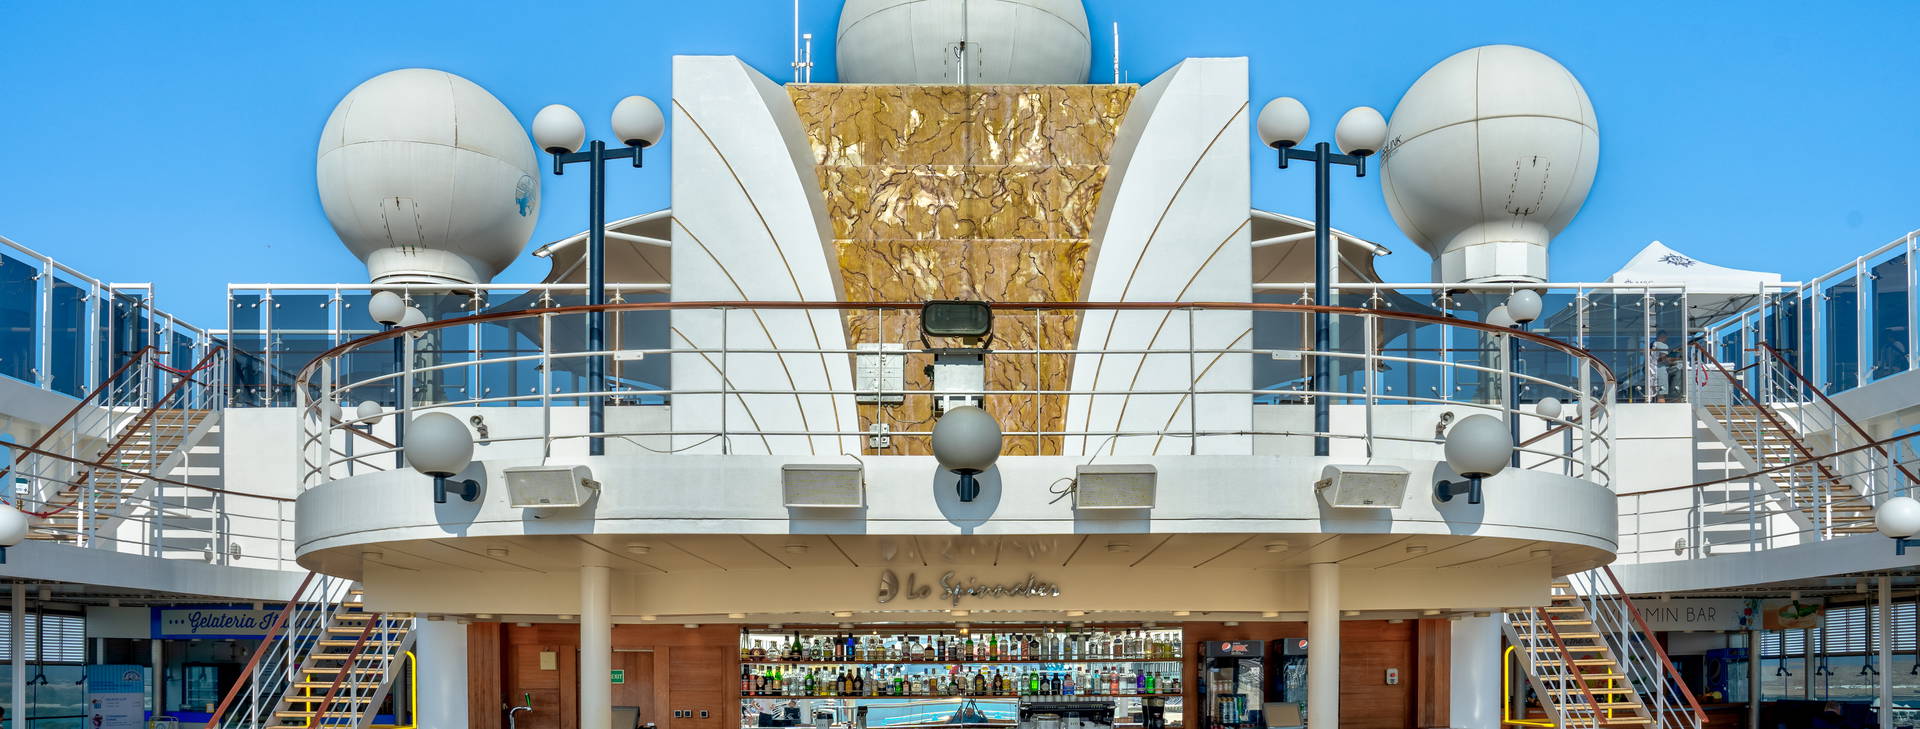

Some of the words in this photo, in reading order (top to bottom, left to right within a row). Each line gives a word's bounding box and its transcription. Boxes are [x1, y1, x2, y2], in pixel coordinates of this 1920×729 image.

[907, 572, 932, 600] Lo
[188, 611, 257, 633] Gelateria
[1604, 607, 1679, 623] VIAMIN
[1687, 607, 1716, 623] BAR
